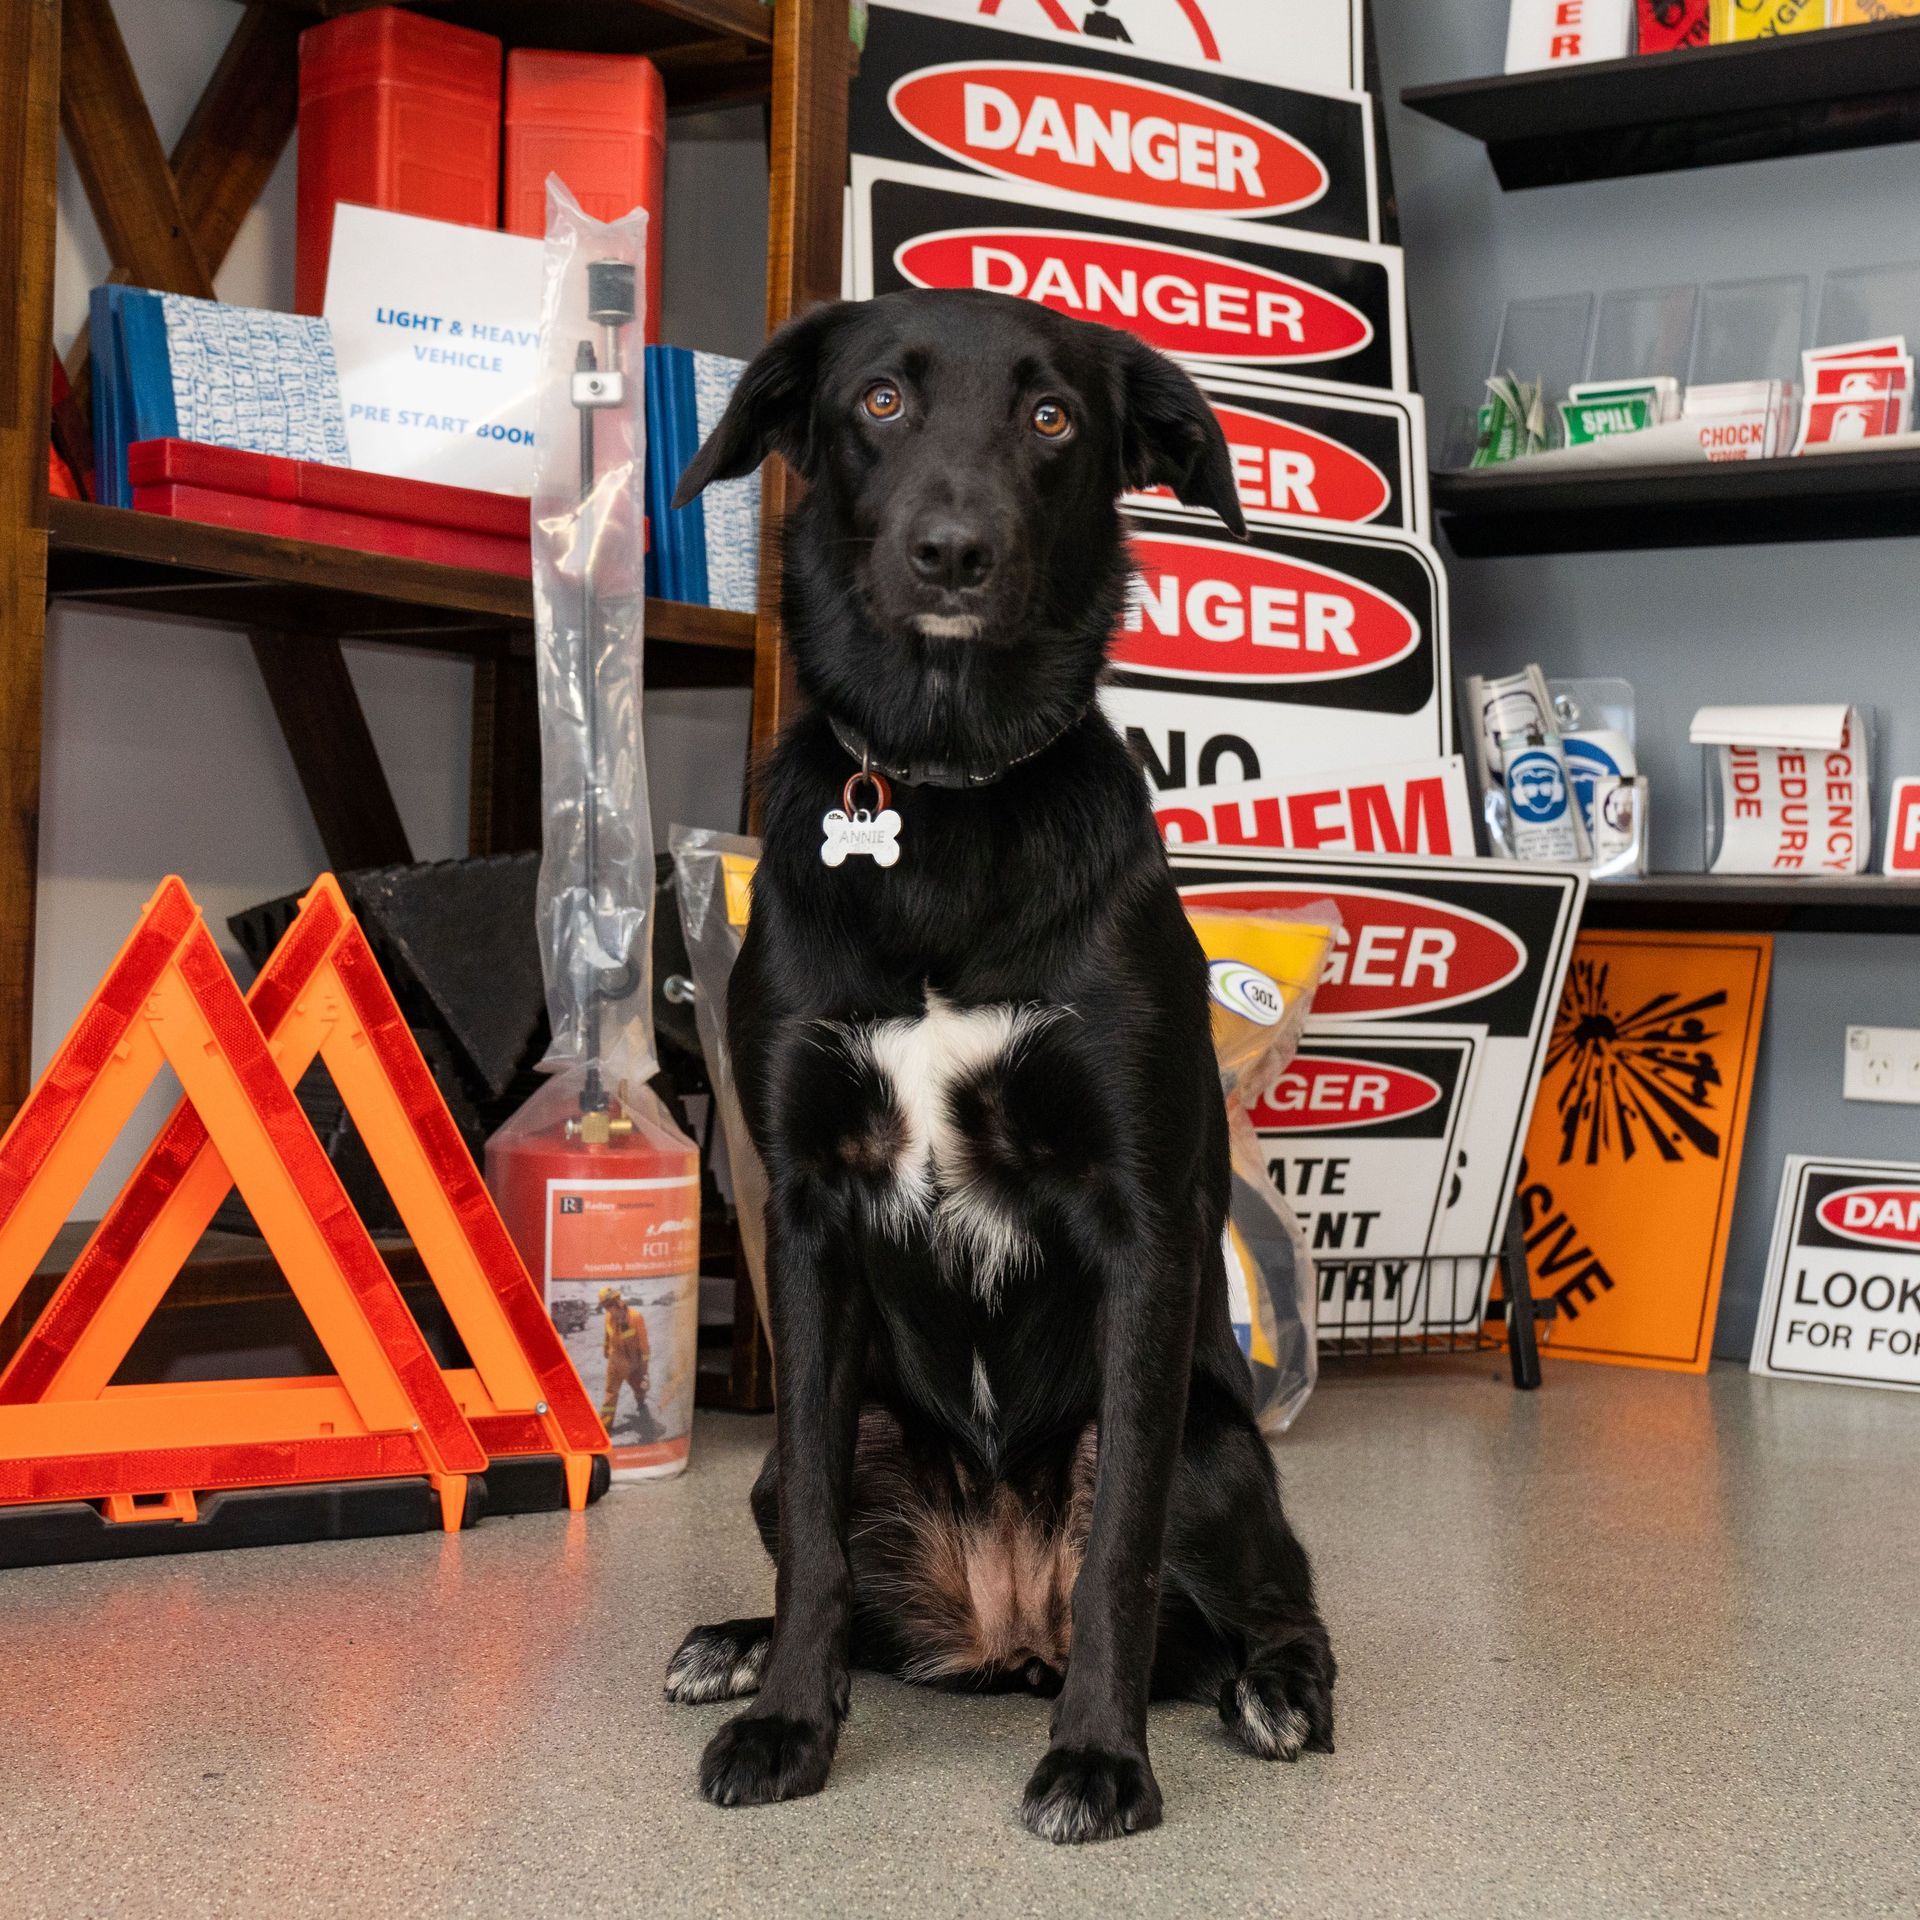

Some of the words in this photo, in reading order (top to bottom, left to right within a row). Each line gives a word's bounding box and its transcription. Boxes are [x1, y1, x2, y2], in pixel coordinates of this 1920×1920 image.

[964, 82, 1266, 198] DANGER
[971, 245, 1305, 343] DANGER
[376, 308, 443, 332] LIGHT
[449, 321, 464, 336] &
[414, 345, 503, 373] VEHICLE
[350, 403, 391, 423] PRE
[398, 410, 470, 434] START
[1581, 409, 1636, 435] SPILL
[1699, 424, 1763, 448] CHOCK
[1773, 747, 1809, 869] EDURE
[840, 830, 885, 844] ANNIE
[1250, 985, 1278, 1010] 30L
[1518, 1155, 1615, 1321] SIVE
[1794, 1269, 1920, 1313] LOOK
[1787, 1320, 1852, 1349] FOR
